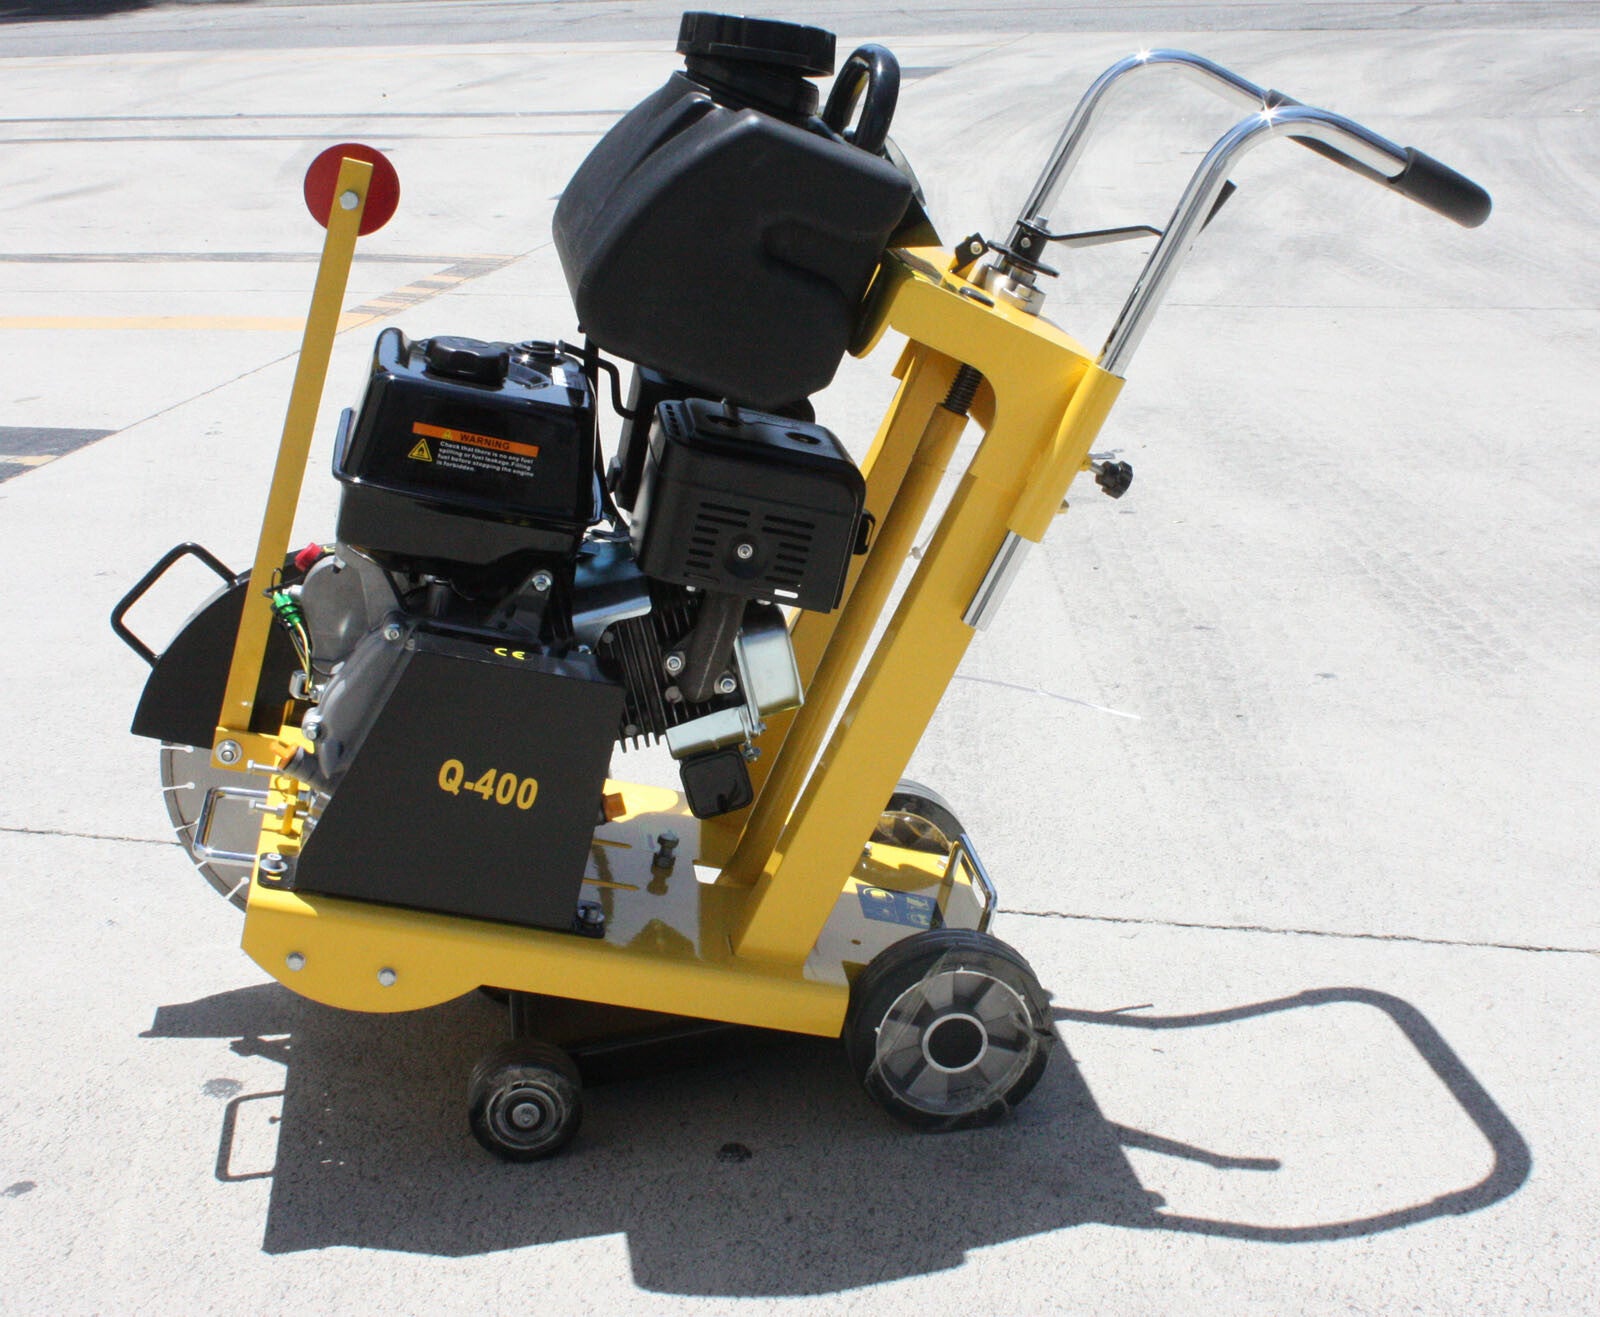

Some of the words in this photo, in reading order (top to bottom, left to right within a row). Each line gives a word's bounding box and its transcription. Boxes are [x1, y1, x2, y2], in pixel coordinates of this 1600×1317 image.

[440, 441, 460, 449] Check
[461, 445, 474, 453] that
[474, 448, 491, 456] there
[460, 433, 510, 450] WARNING
[438, 448, 463, 457] spilling
[451, 456, 471, 464] before
[472, 461, 501, 471] stopping
[438, 758, 538, 810] Q-400
